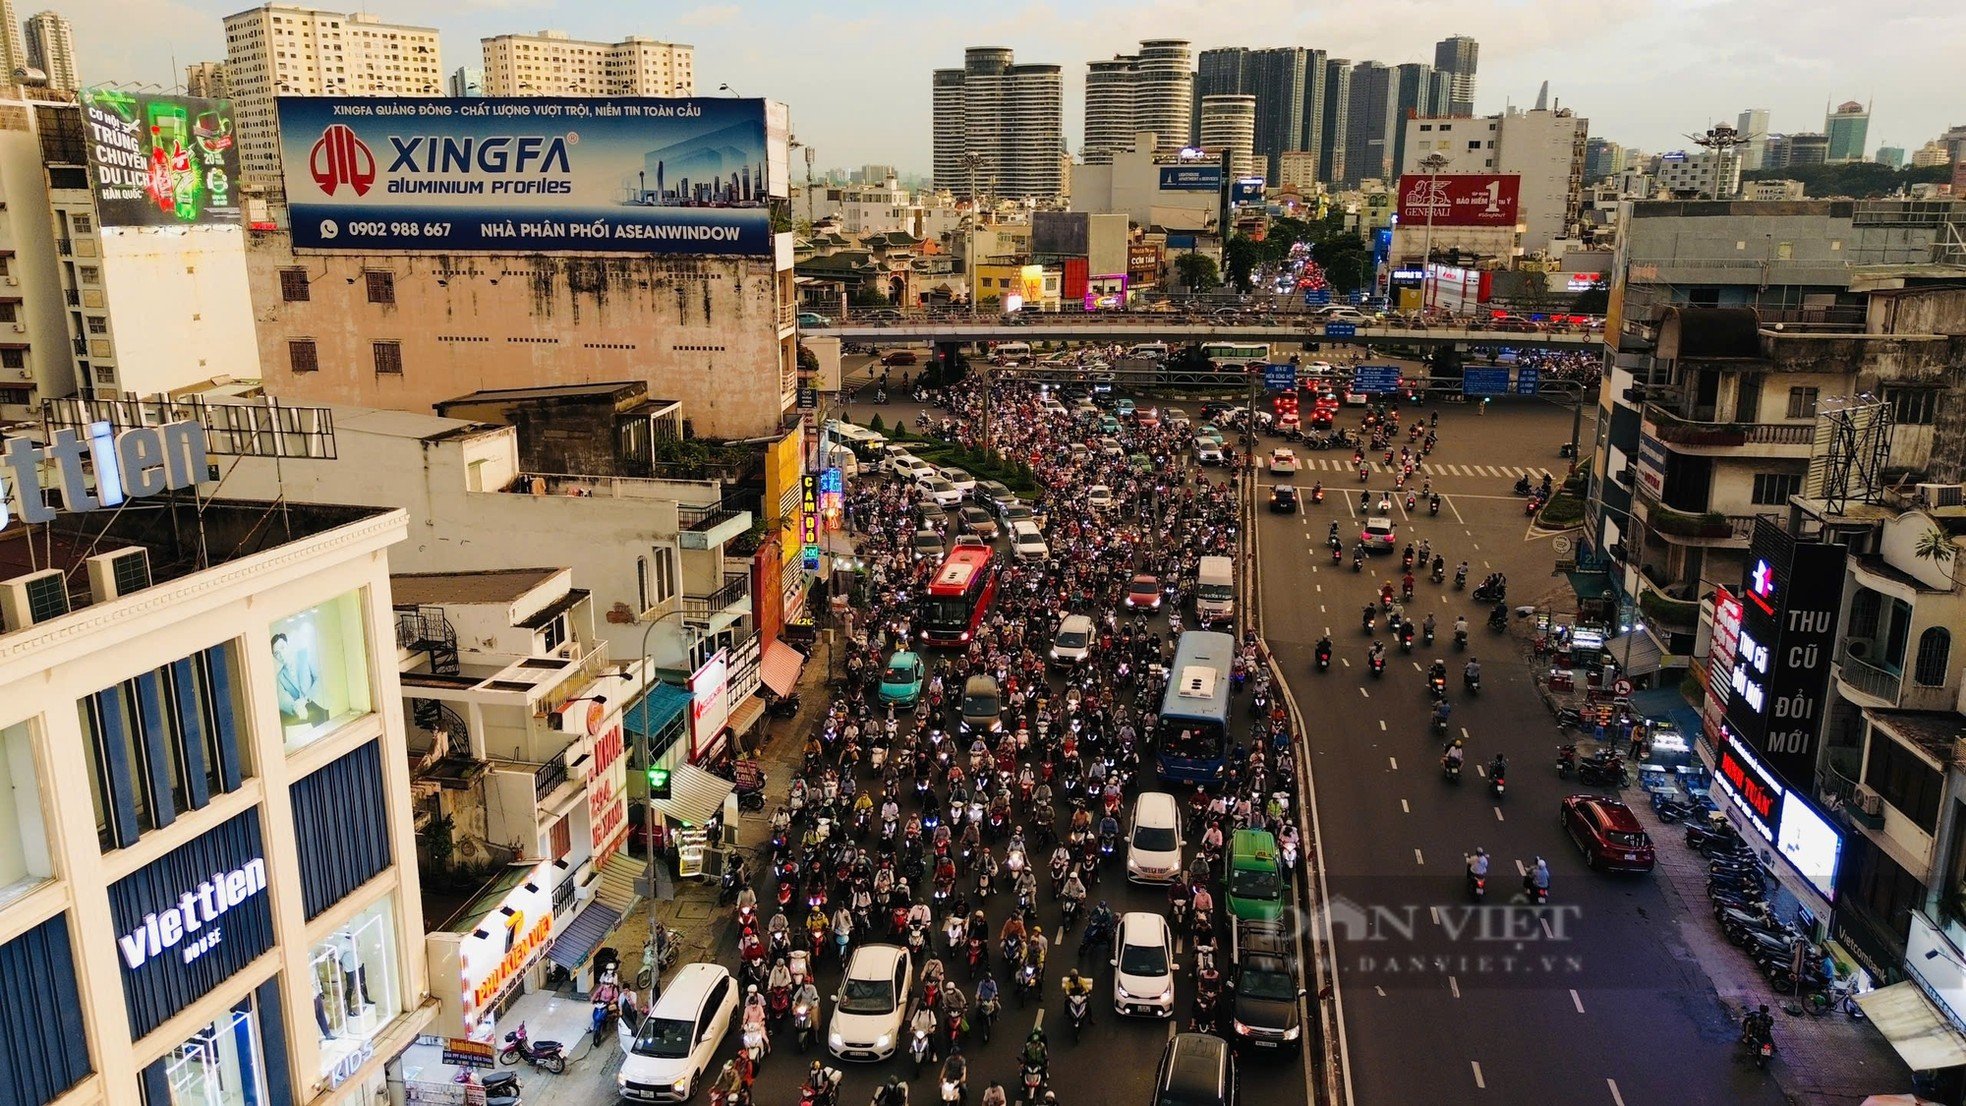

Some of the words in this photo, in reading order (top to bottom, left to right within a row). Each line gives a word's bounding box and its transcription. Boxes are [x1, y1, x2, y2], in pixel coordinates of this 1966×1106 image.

[333, 105, 374, 116] XINGFA
[376, 102, 416, 116] QUẢNG
[419, 103, 452, 116] ĐÔNG
[460, 102, 490, 116] CHẤT
[493, 104, 531, 118] LƯỢNG
[534, 105, 562, 117] VƯỢT
[565, 103, 593, 118] TRỘI,
[595, 103, 621, 117] NIỀM
[624, 106, 641, 117] TIN
[643, 103, 674, 117] TOÀN
[676, 102, 701, 117] CẦU
[387, 136, 571, 174] XINGFA
[99, 165, 122, 185] DU
[349, 222, 387, 237] 0902
[391, 222, 420, 237] 988
[423, 222, 451, 237] 667
[481, 219, 516, 238] NHÀ
[521, 219, 566, 238] PHÂN
[570, 217, 610, 239] PHỐI
[614, 225, 741, 242] ASEANWINDOW
[1788, 609, 1831, 634] THU
[1788, 643, 1819, 669] CŨ
[1775, 688, 1813, 720] ĐỔI
[1767, 730, 1808, 754] MỚI
[118, 857, 267, 970] viettien
[1839, 924, 1888, 985] Vietcombank
[331, 1039, 375, 1092] KIDS
